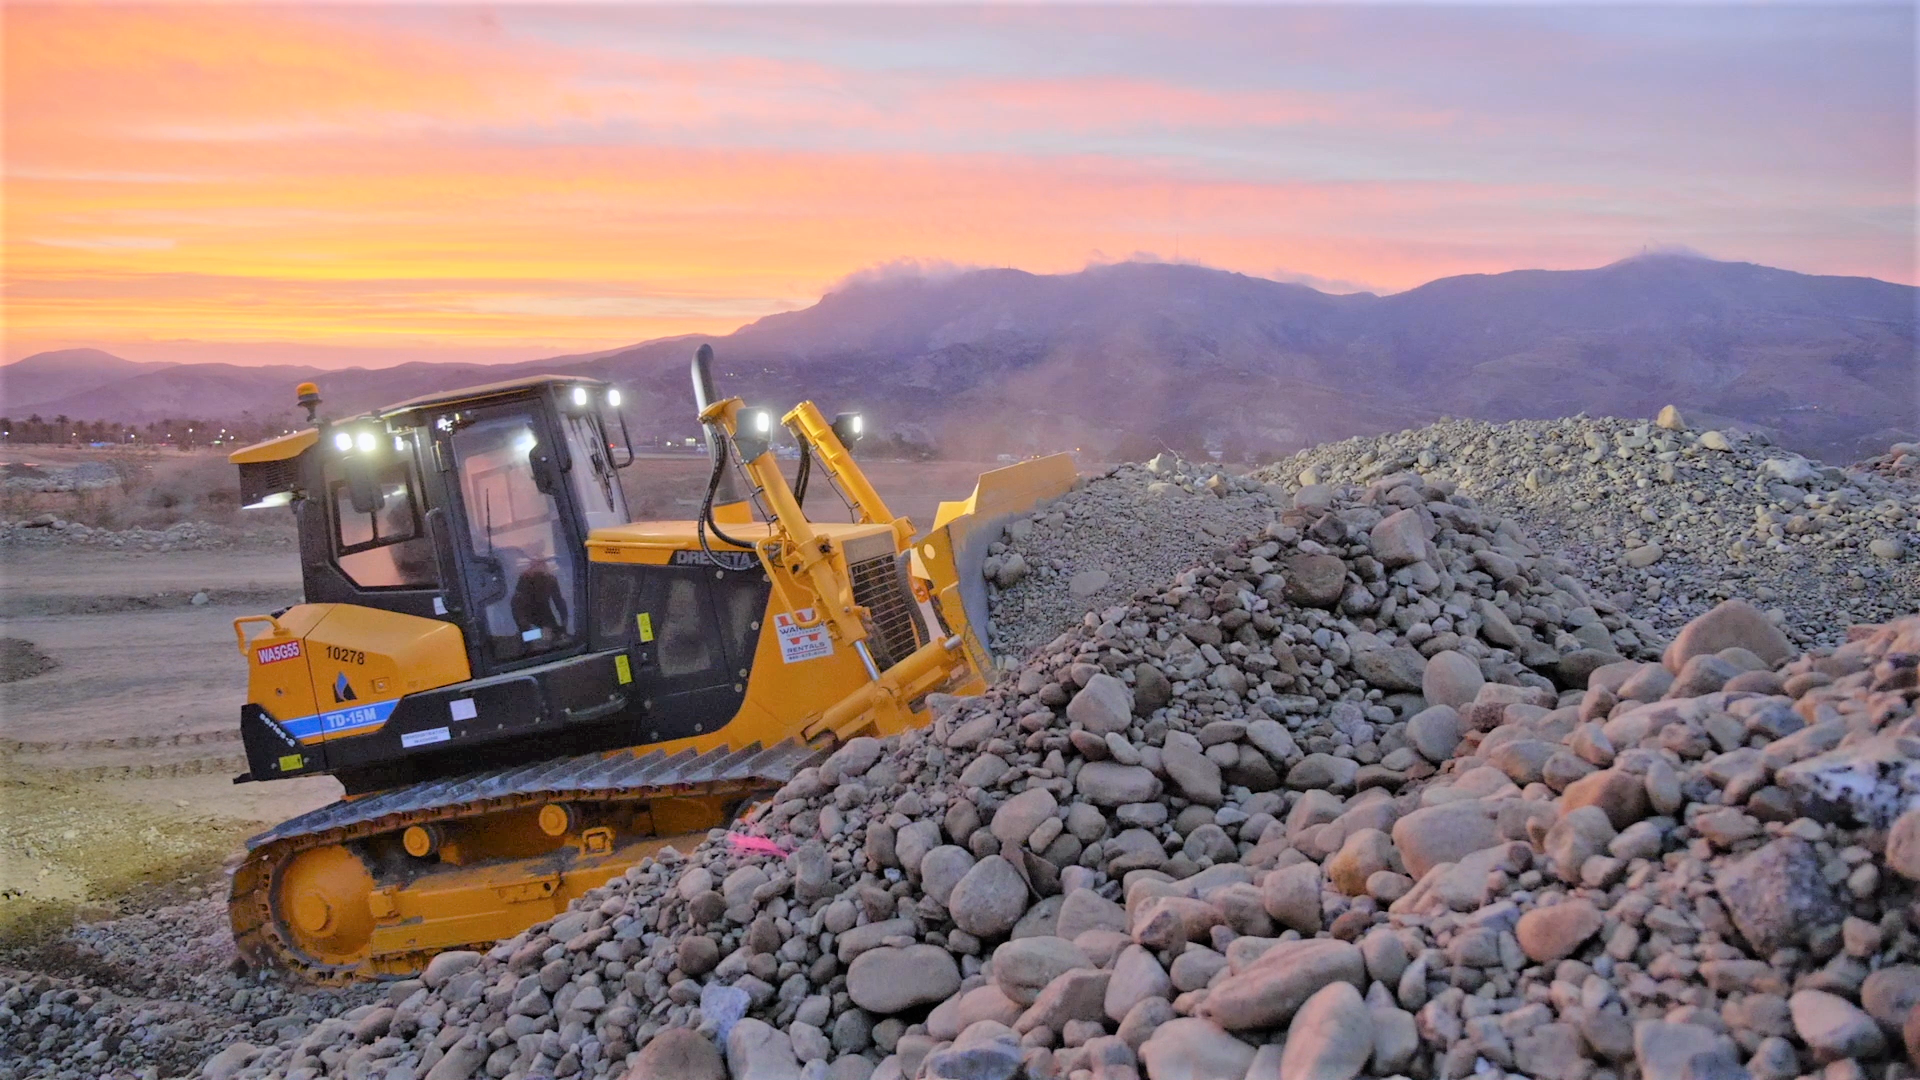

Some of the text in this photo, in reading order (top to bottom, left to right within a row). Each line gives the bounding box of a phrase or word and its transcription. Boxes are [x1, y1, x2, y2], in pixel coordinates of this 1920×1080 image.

[258, 642, 300, 664] WA5G55
[326, 646, 365, 665] 10278
[787, 642, 826, 653] RENTALS
[327, 707, 377, 728] TD-15M
